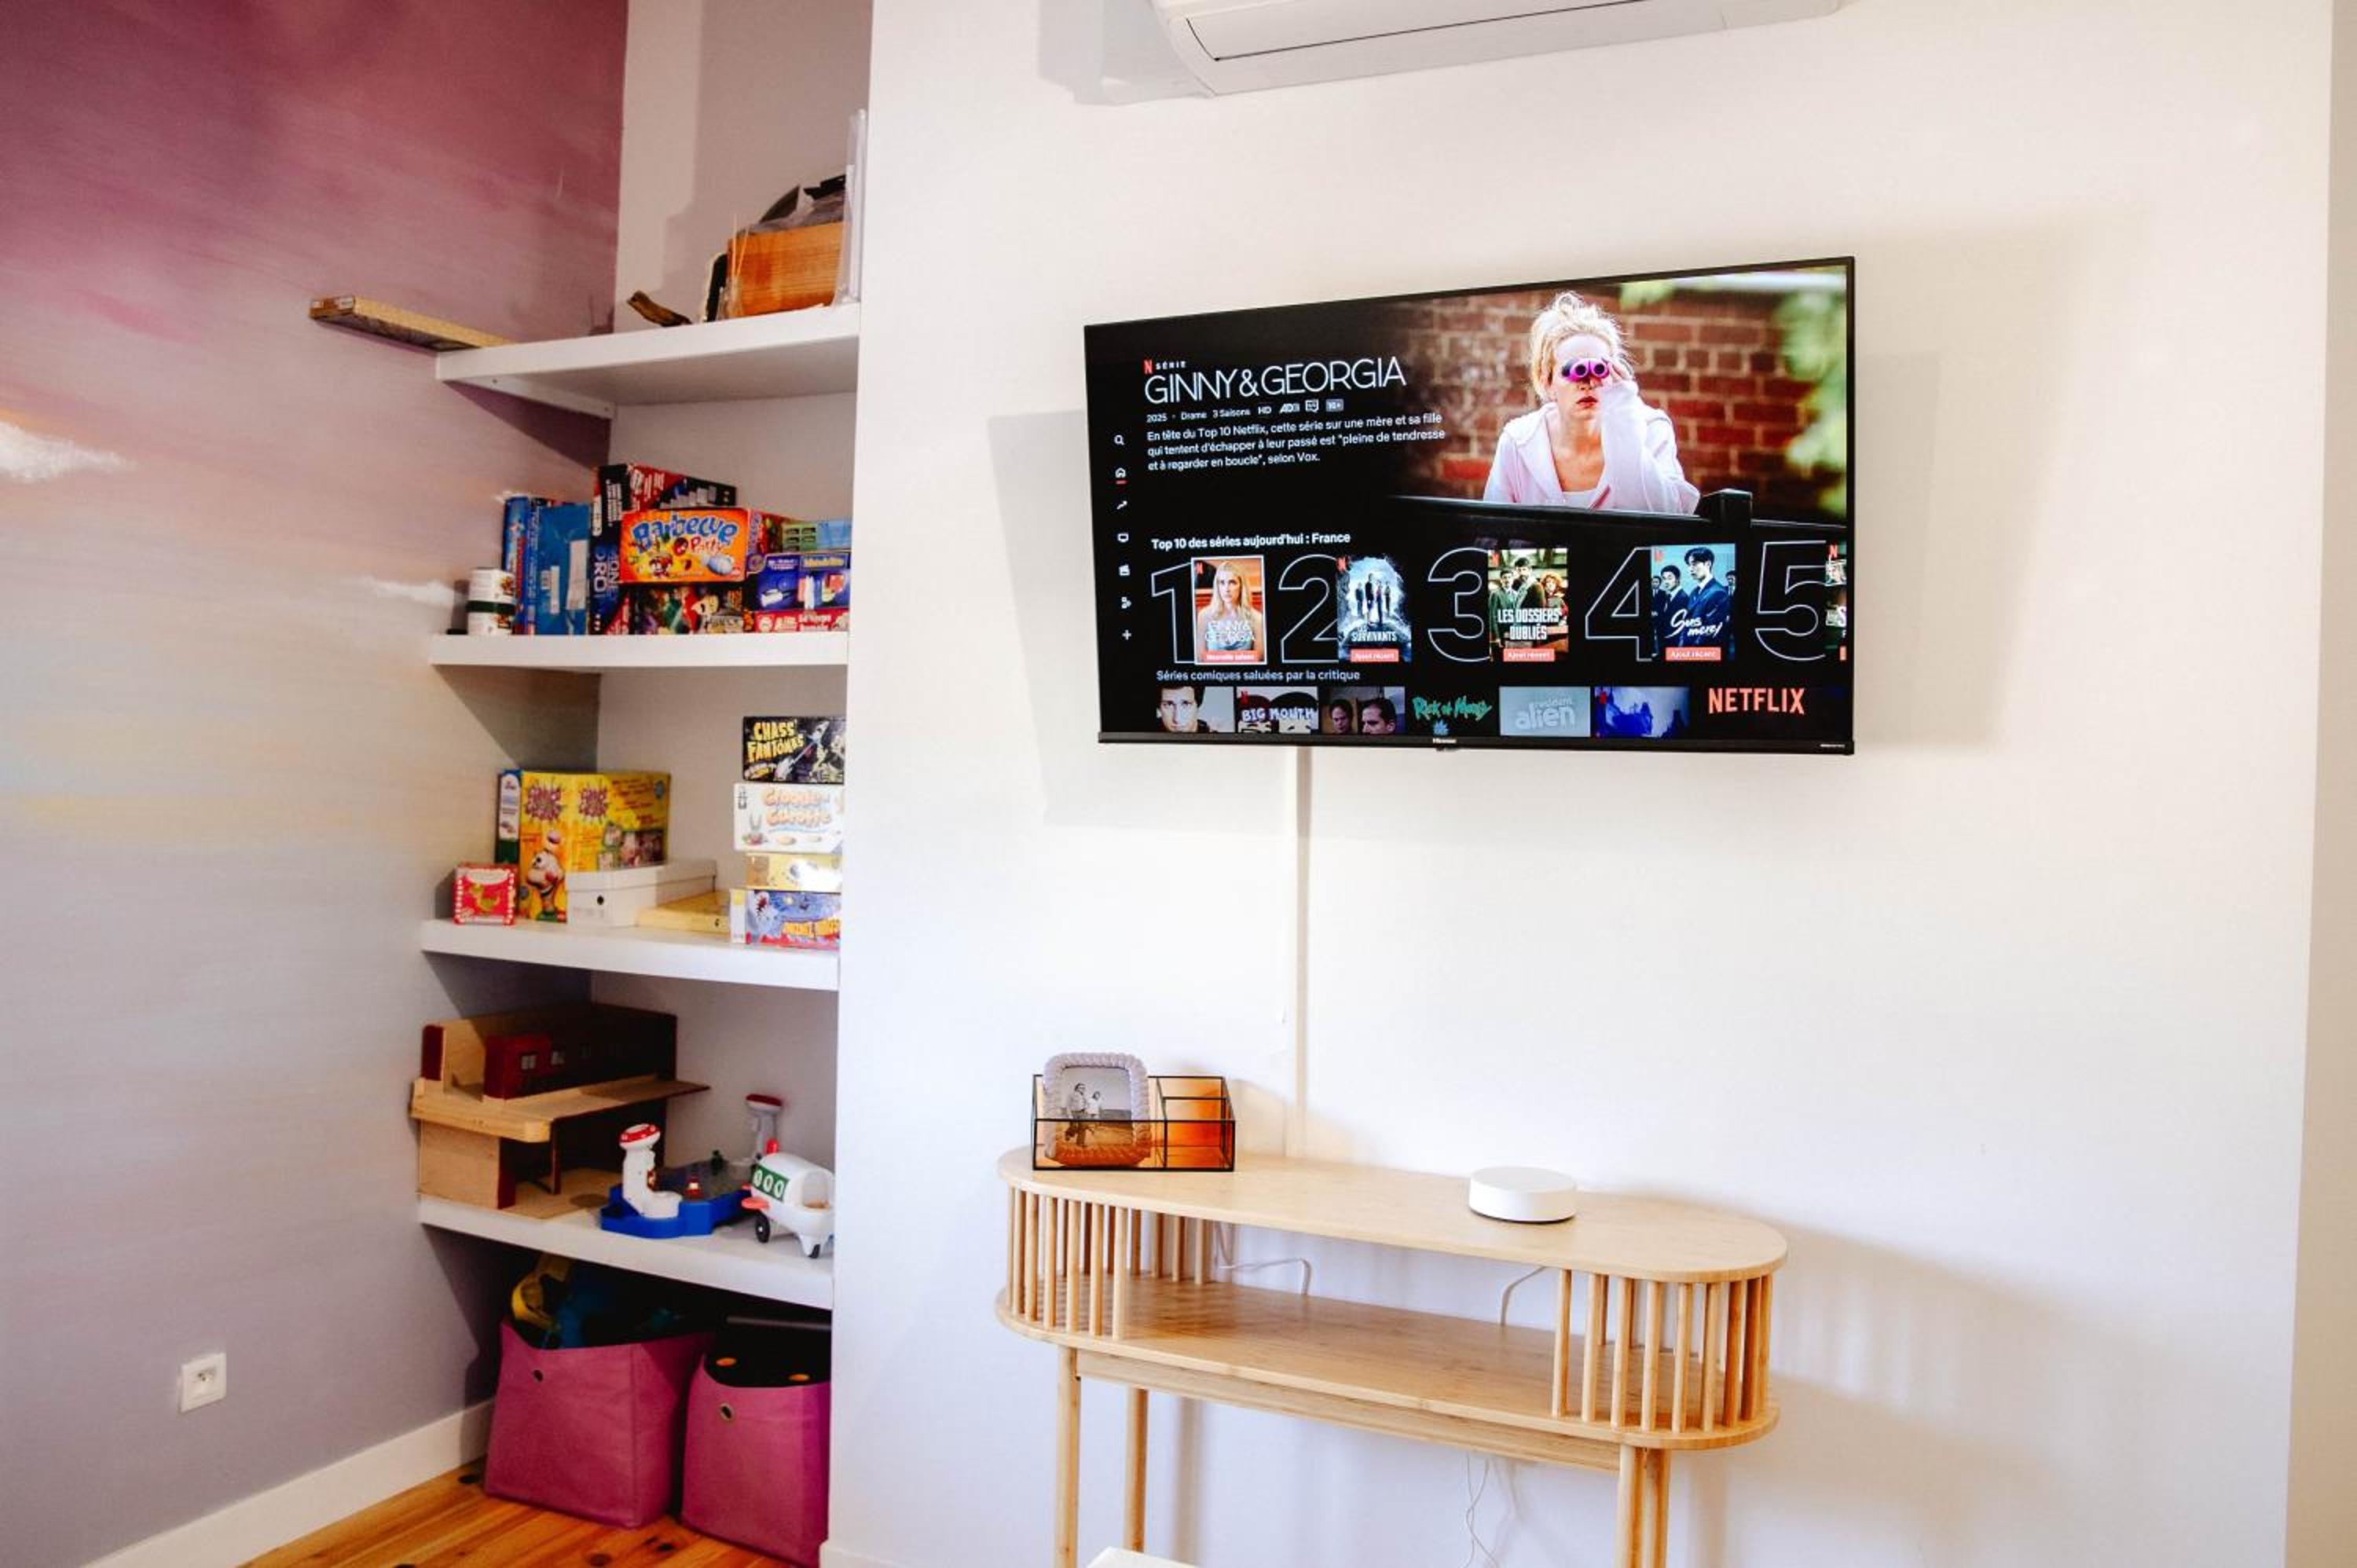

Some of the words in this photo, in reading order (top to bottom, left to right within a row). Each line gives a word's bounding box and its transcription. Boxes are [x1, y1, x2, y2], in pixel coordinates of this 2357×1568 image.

[1146, 414, 1168, 423] 2025
[1147, 431, 1160, 441] En
[1162, 430, 1181, 441] tête
[1182, 428, 1196, 439] du
[1198, 427, 1218, 438] Top
[1219, 427, 1231, 436] 10
[1233, 423, 1269, 435] Netflix,
[1270, 422, 1297, 432] cette
[1299, 419, 1324, 431] série
[1325, 420, 1342, 430] sur
[1344, 418, 1364, 429] une
[1366, 416, 1393, 427] mère
[1395, 415, 1406, 425] et
[1409, 415, 1420, 424] sa
[1423, 412, 1442, 424] fille
[1148, 446, 1164, 457] qui
[1164, 443, 1200, 455] tentent
[1200, 441, 1256, 453] d'échapper
[1258, 441, 1264, 450] à
[1266, 438, 1285, 449] leur
[1288, 437, 1318, 449] passé
[1319, 436, 1336, 446] est
[1376, 431, 1390, 442] de
[1392, 429, 1446, 441] tendresse
[1148, 460, 1158, 471] et
[1160, 460, 1165, 471] à
[1168, 458, 1208, 471] regarder
[1211, 457, 1223, 467] en
[1267, 454, 1296, 464] selon
[1296, 452, 1321, 463] Vox.
[632, 511, 739, 554] Barbecue
[1151, 538, 1172, 551] Top
[1174, 538, 1187, 549] 10
[1189, 537, 1208, 548] des
[1209, 536, 1241, 548] séries
[1243, 533, 1303, 549] aujourd'hui
[1311, 532, 1351, 544] France
[1278, 554, 1339, 663] 2
[1427, 547, 1491, 662] 3
[1585, 546, 1651, 662] 4
[1755, 540, 1827, 661] 5
[1497, 609, 1514, 624] LES
[1516, 607, 1560, 624] DOSSIERS
[1509, 623, 1547, 640] OUBLIÉS
[1157, 670, 1189, 682] Séries
[1190, 670, 1241, 682] comiques
[1244, 669, 1284, 681] saluées
[1286, 672, 1303, 683] par
[1306, 669, 1316, 680] la
[1318, 670, 1361, 682] critique
[1241, 709, 1266, 722] BIG
[1270, 705, 1317, 721] MOUTH
[1709, 687, 1805, 715] NETFLIX
[1515, 702, 1576, 730] alien
